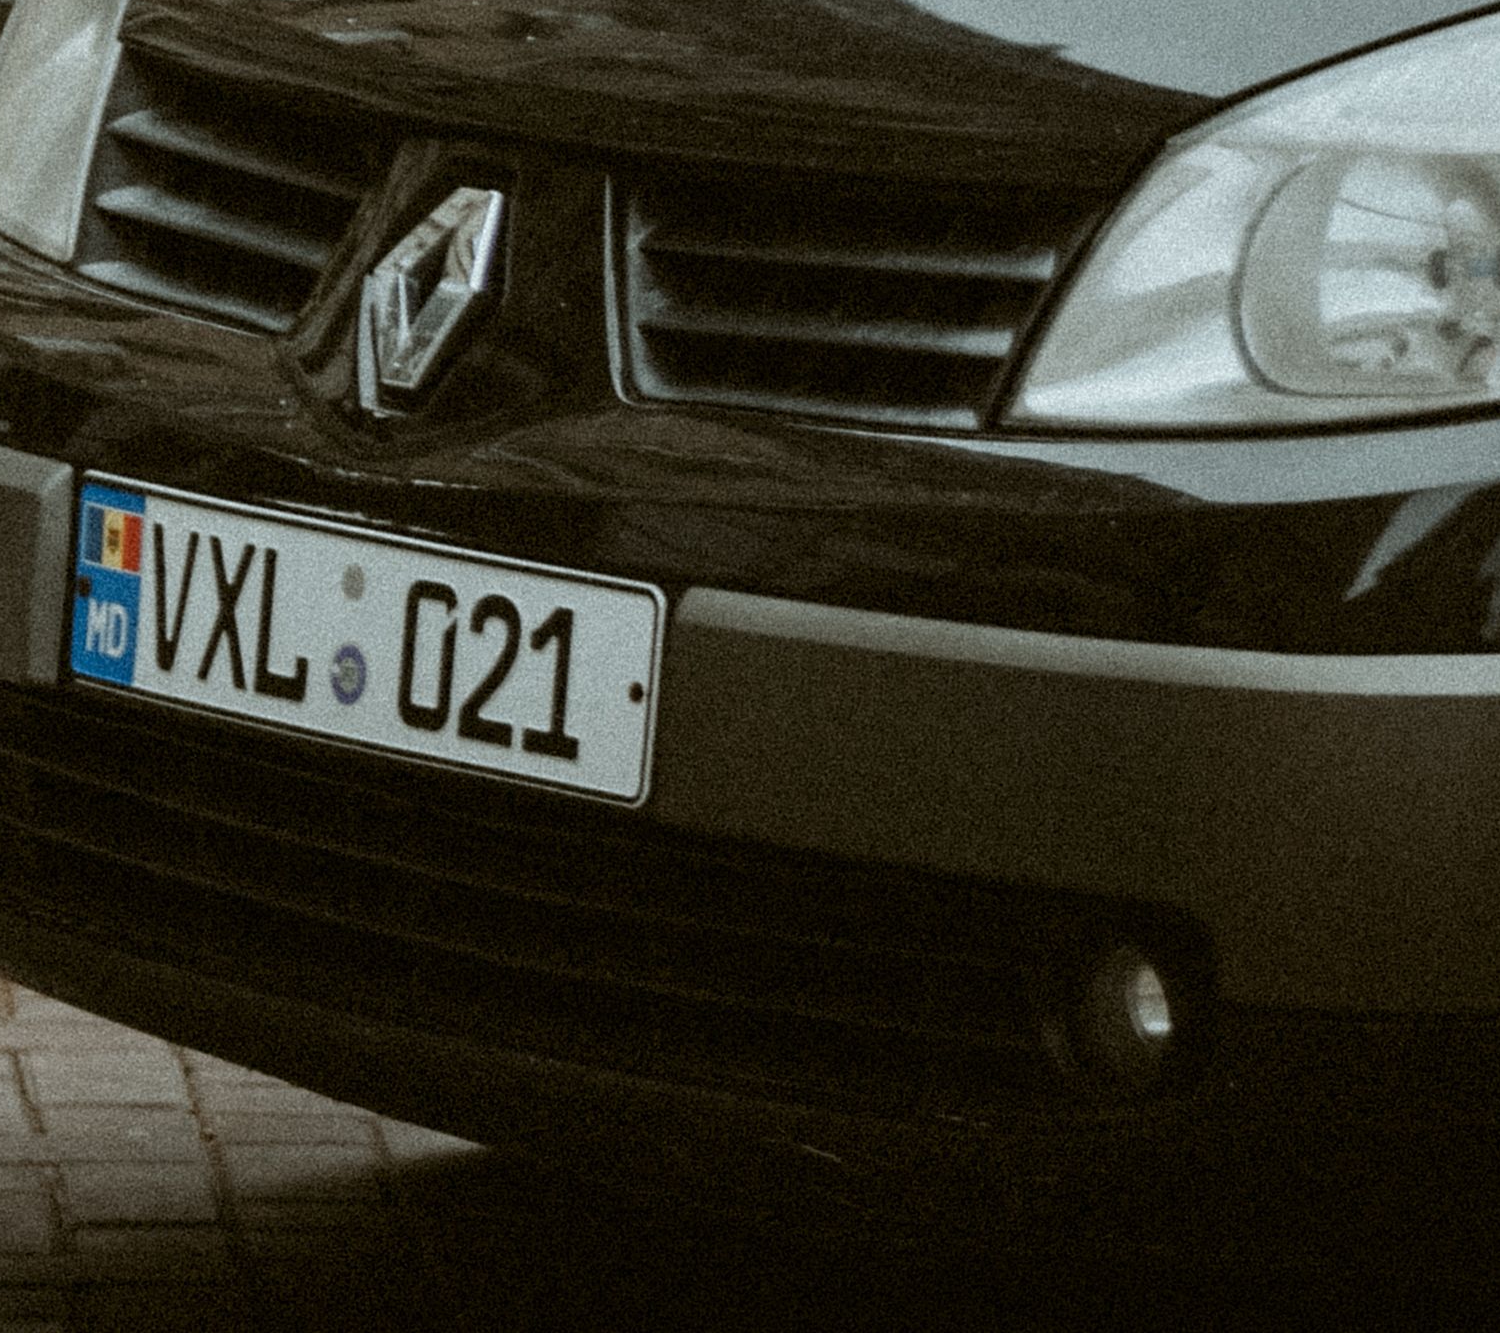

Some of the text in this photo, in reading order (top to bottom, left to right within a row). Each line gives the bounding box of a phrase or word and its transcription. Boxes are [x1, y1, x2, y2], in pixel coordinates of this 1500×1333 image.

[84, 597, 128, 659] MD
[153, 522, 580, 762] VXL 021
